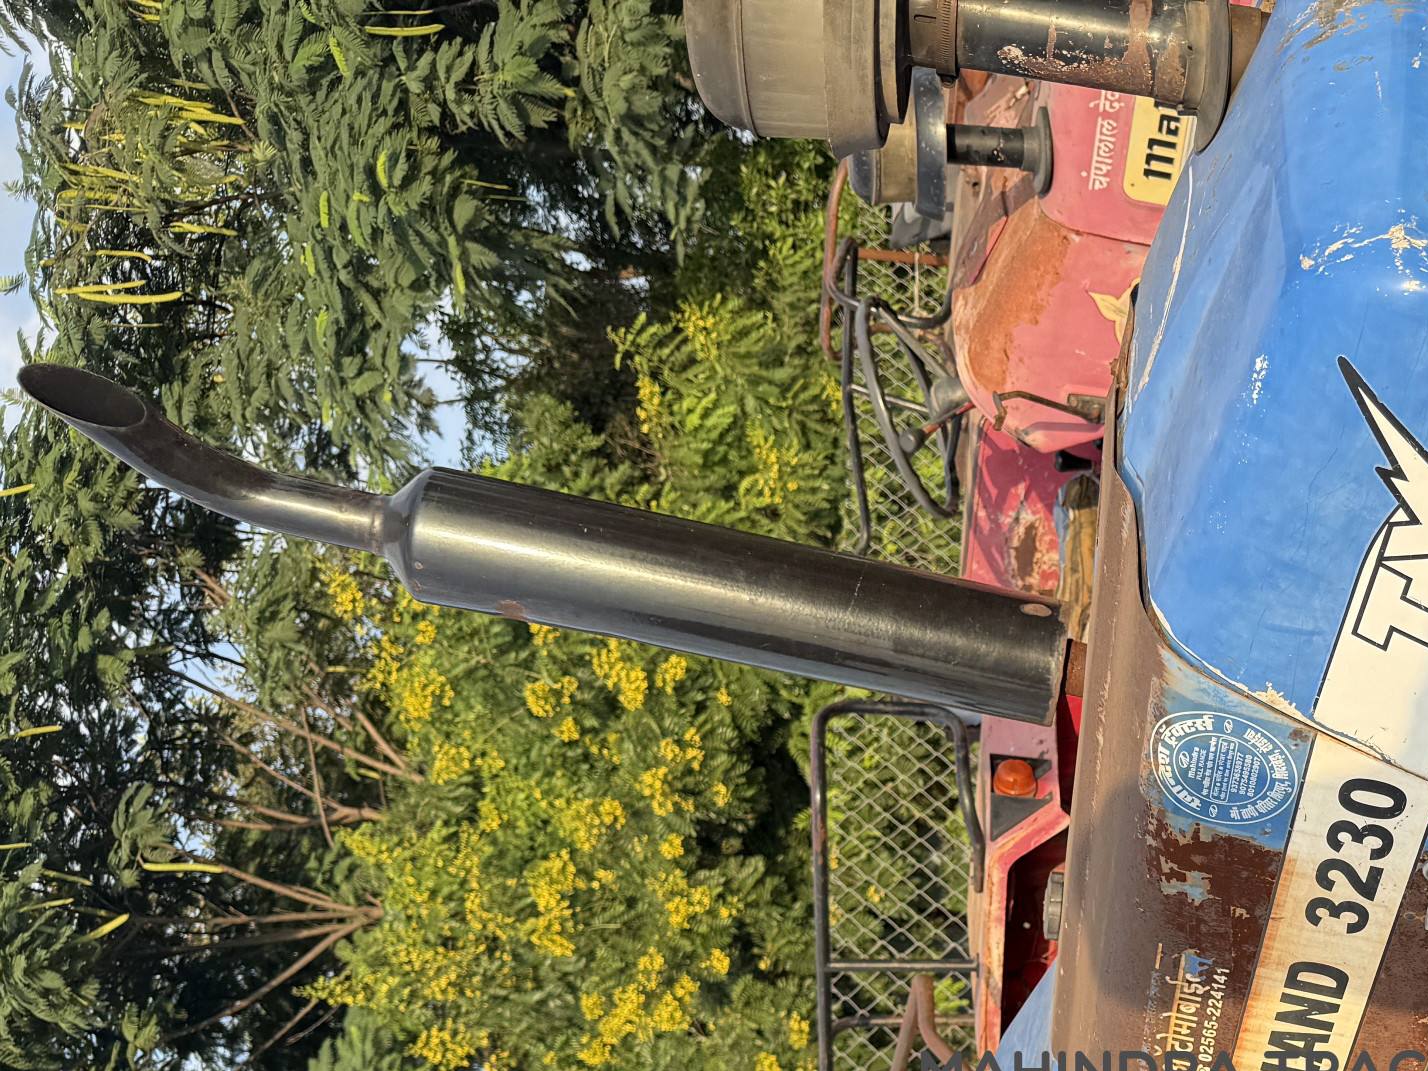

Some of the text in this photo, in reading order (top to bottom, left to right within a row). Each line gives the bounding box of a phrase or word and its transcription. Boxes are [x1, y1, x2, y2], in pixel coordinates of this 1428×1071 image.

[1081, 117, 1118, 191] चंपालाल
[1304, 777, 1407, 934] 3230
[1198, 967, 1231, 1063] 02565-224141
